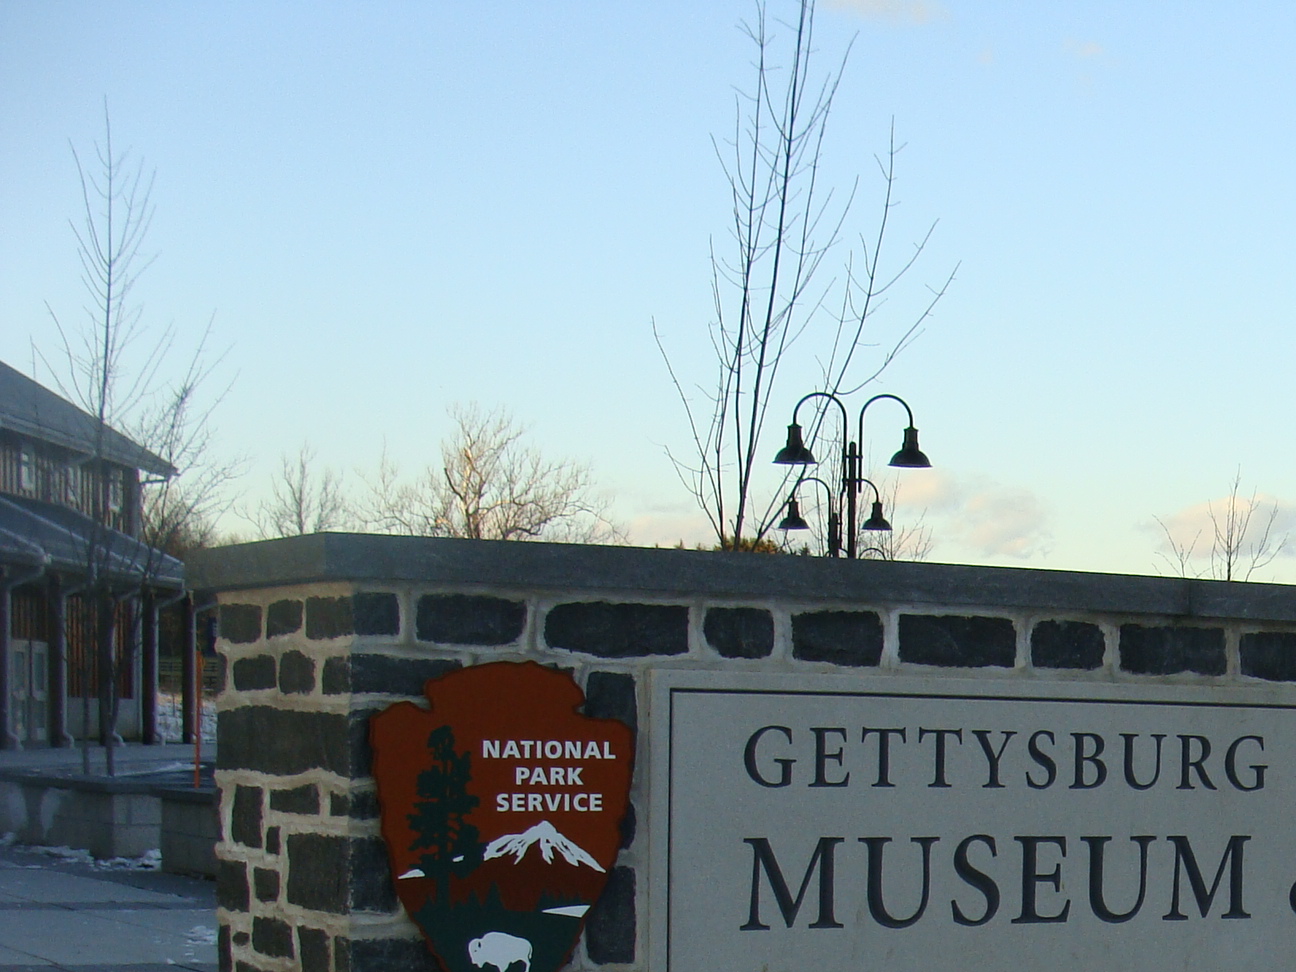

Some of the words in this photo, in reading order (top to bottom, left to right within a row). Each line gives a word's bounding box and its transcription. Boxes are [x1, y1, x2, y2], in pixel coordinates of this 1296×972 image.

[482, 739, 616, 760] NATIONAL
[743, 724, 1269, 792] GETTYSBURG
[515, 767, 584, 786] PARK
[496, 792, 603, 812] SERVICE
[739, 833, 1252, 931] MUSEUM
